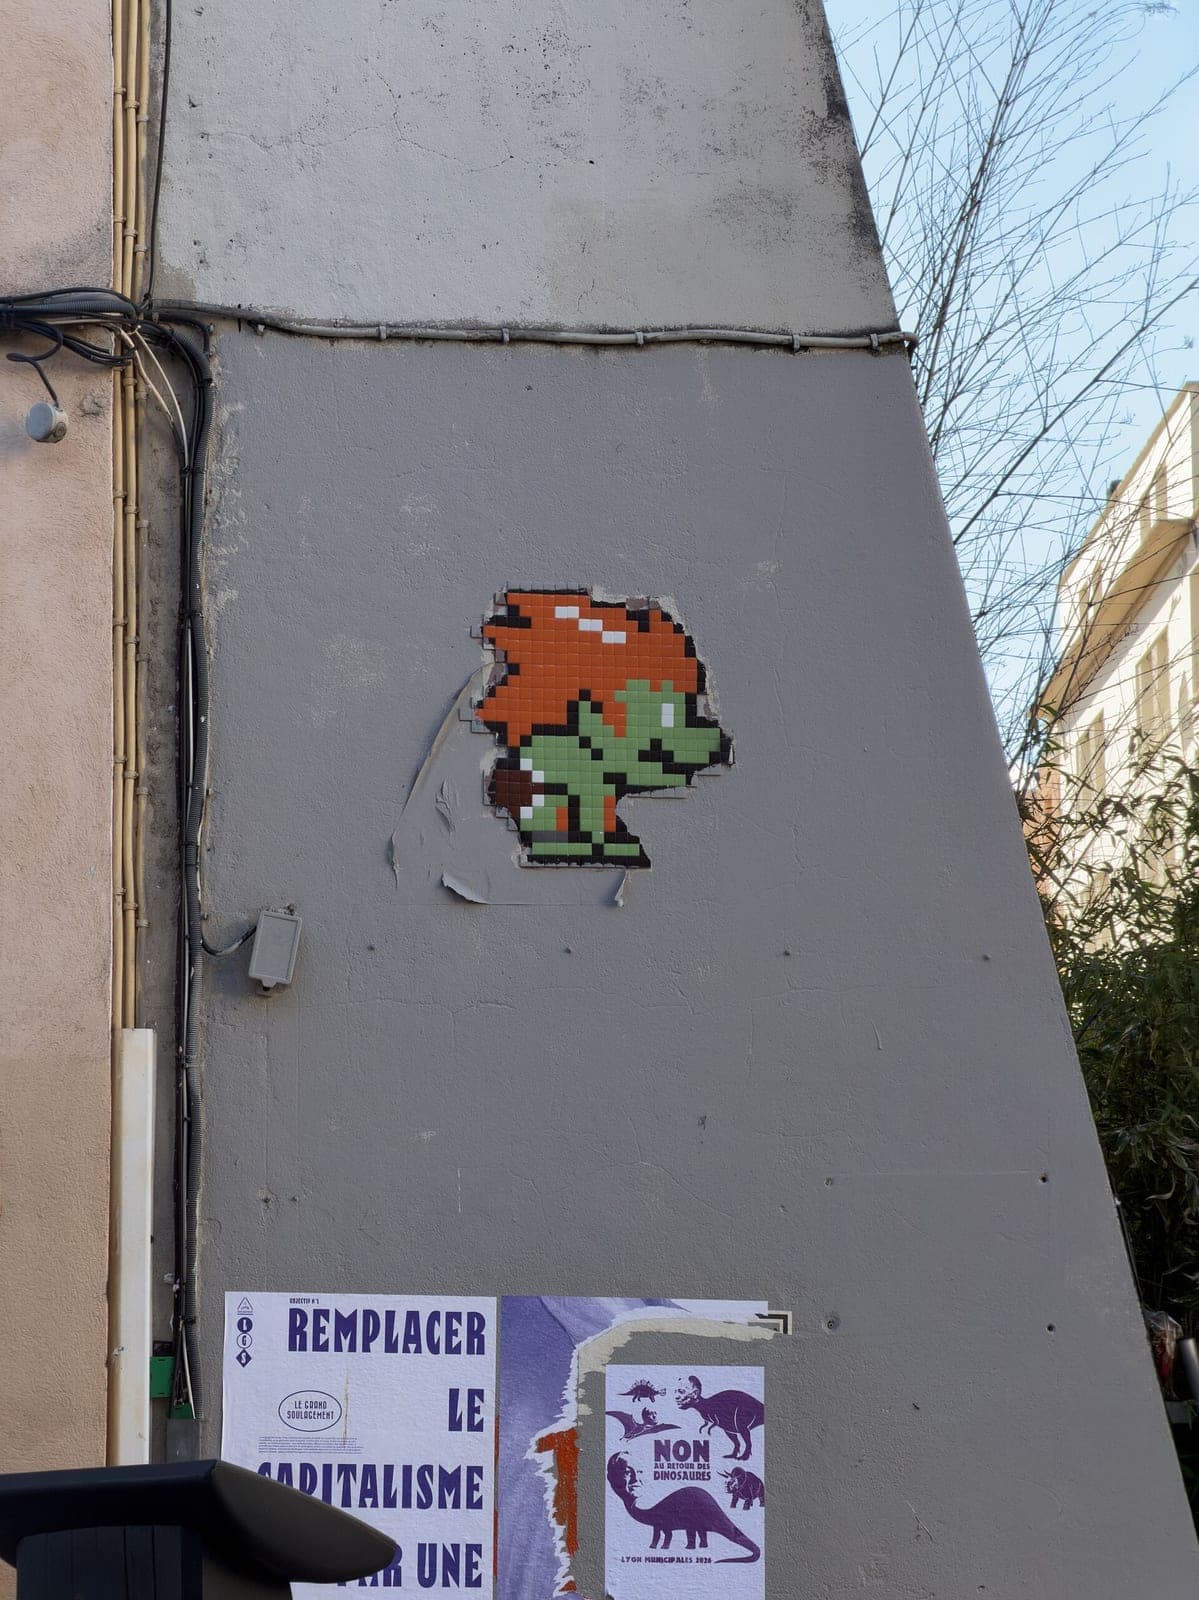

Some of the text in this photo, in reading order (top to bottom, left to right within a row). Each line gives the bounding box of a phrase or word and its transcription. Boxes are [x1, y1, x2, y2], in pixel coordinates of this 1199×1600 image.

[287, 1308, 485, 1355] REMPLACER
[294, 1400, 328, 1410] LE GRAND
[448, 1388, 484, 1432] LE
[286, 1410, 335, 1420] SOULAGEMENT
[653, 1439, 710, 1463] NON
[653, 1470, 711, 1481] DINOSAURES
[417, 1543, 483, 1589] UNE
[644, 1556, 693, 1564] MUNICIPALES
